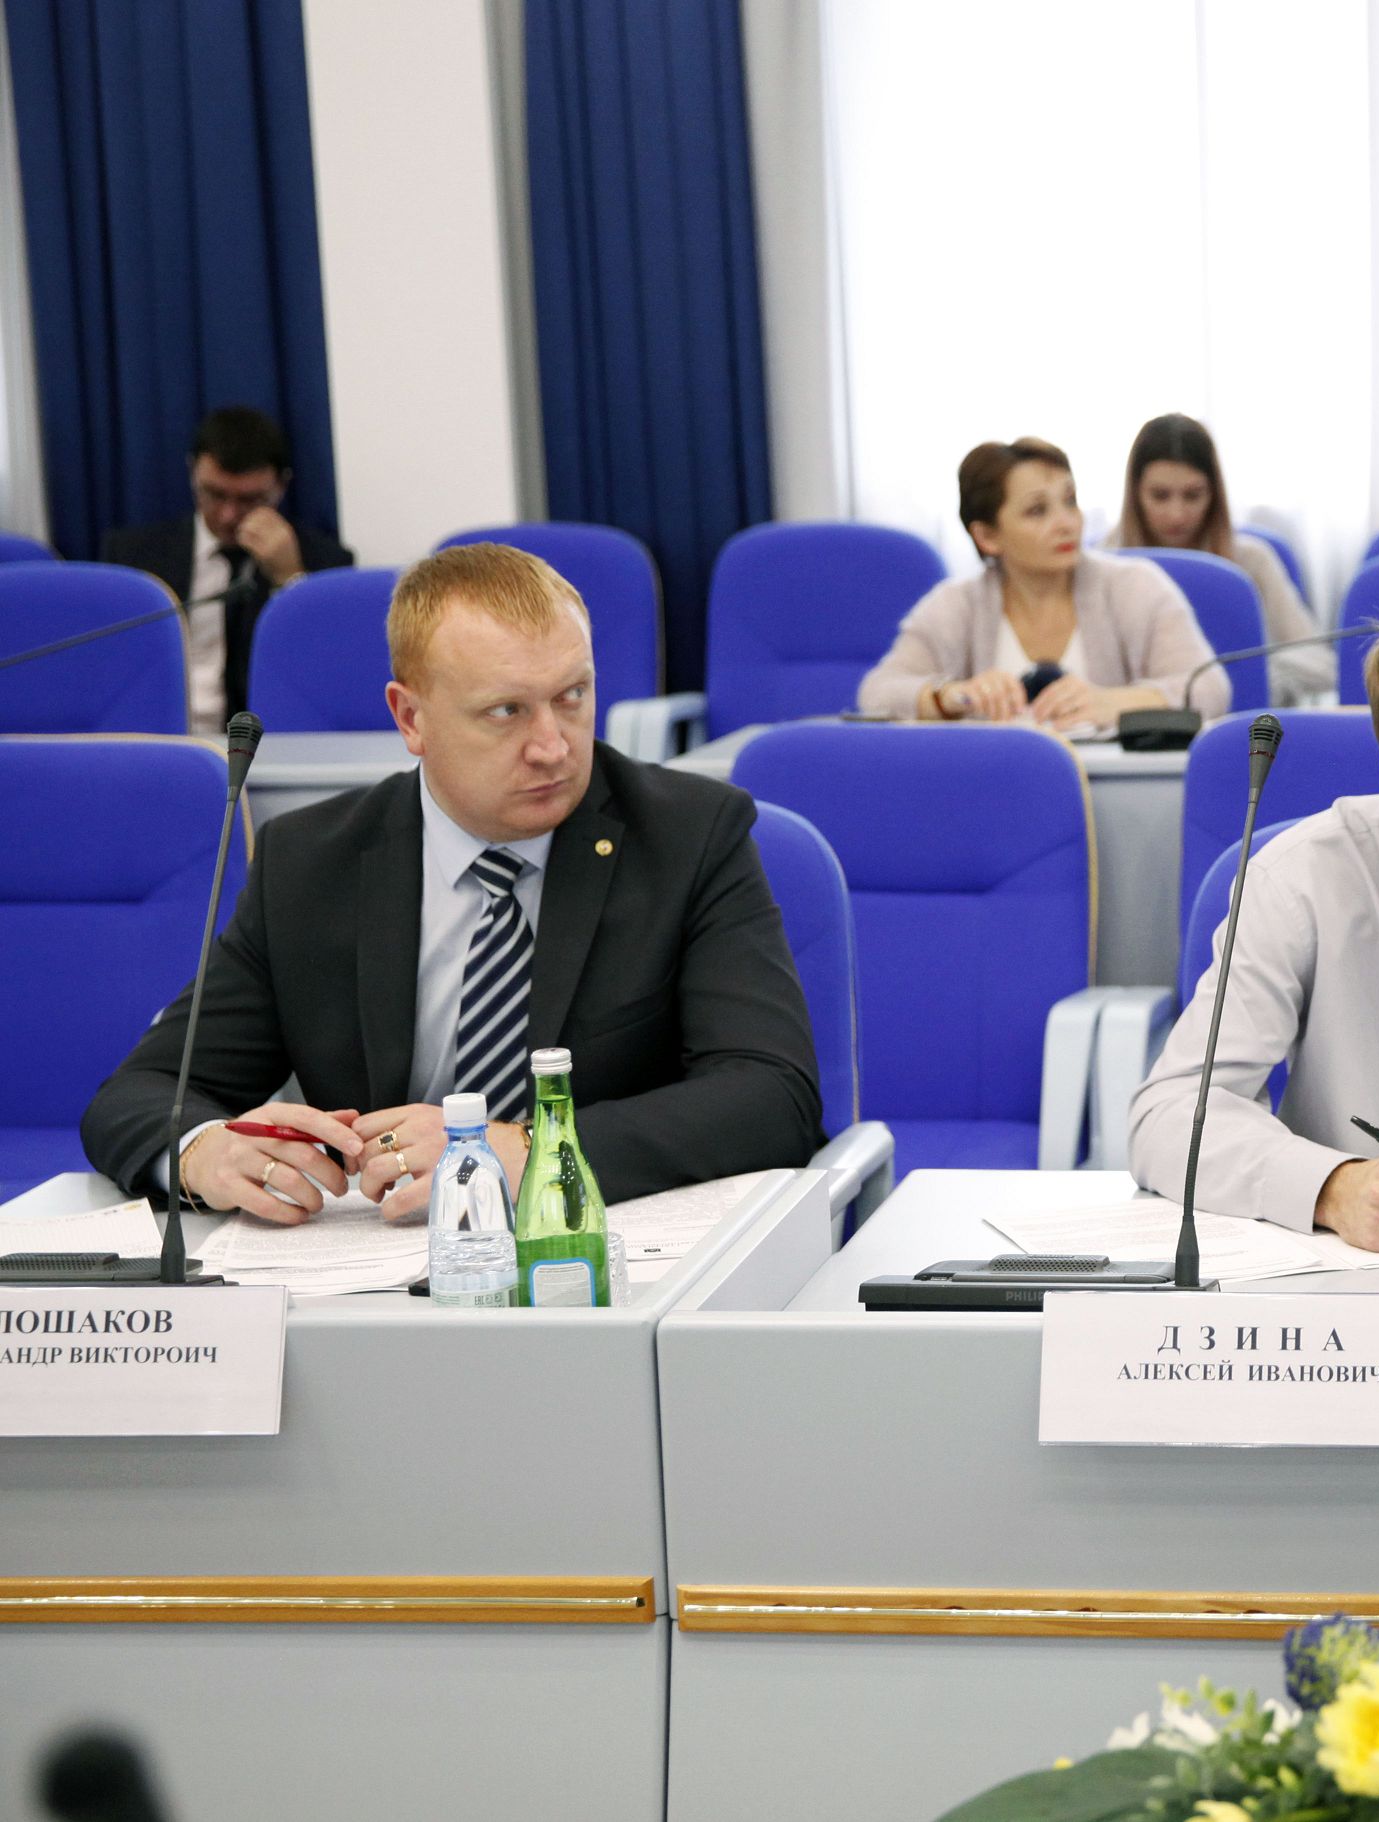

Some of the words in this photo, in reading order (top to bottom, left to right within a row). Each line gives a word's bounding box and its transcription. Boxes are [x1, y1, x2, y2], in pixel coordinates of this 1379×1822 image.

[1157, 1325, 1345, 1353] ДЗИНА
[69, 1346, 217, 1364] ВИКТОРОИЧ
[1117, 1360, 1233, 1381] АЛЕКСЕЙ
